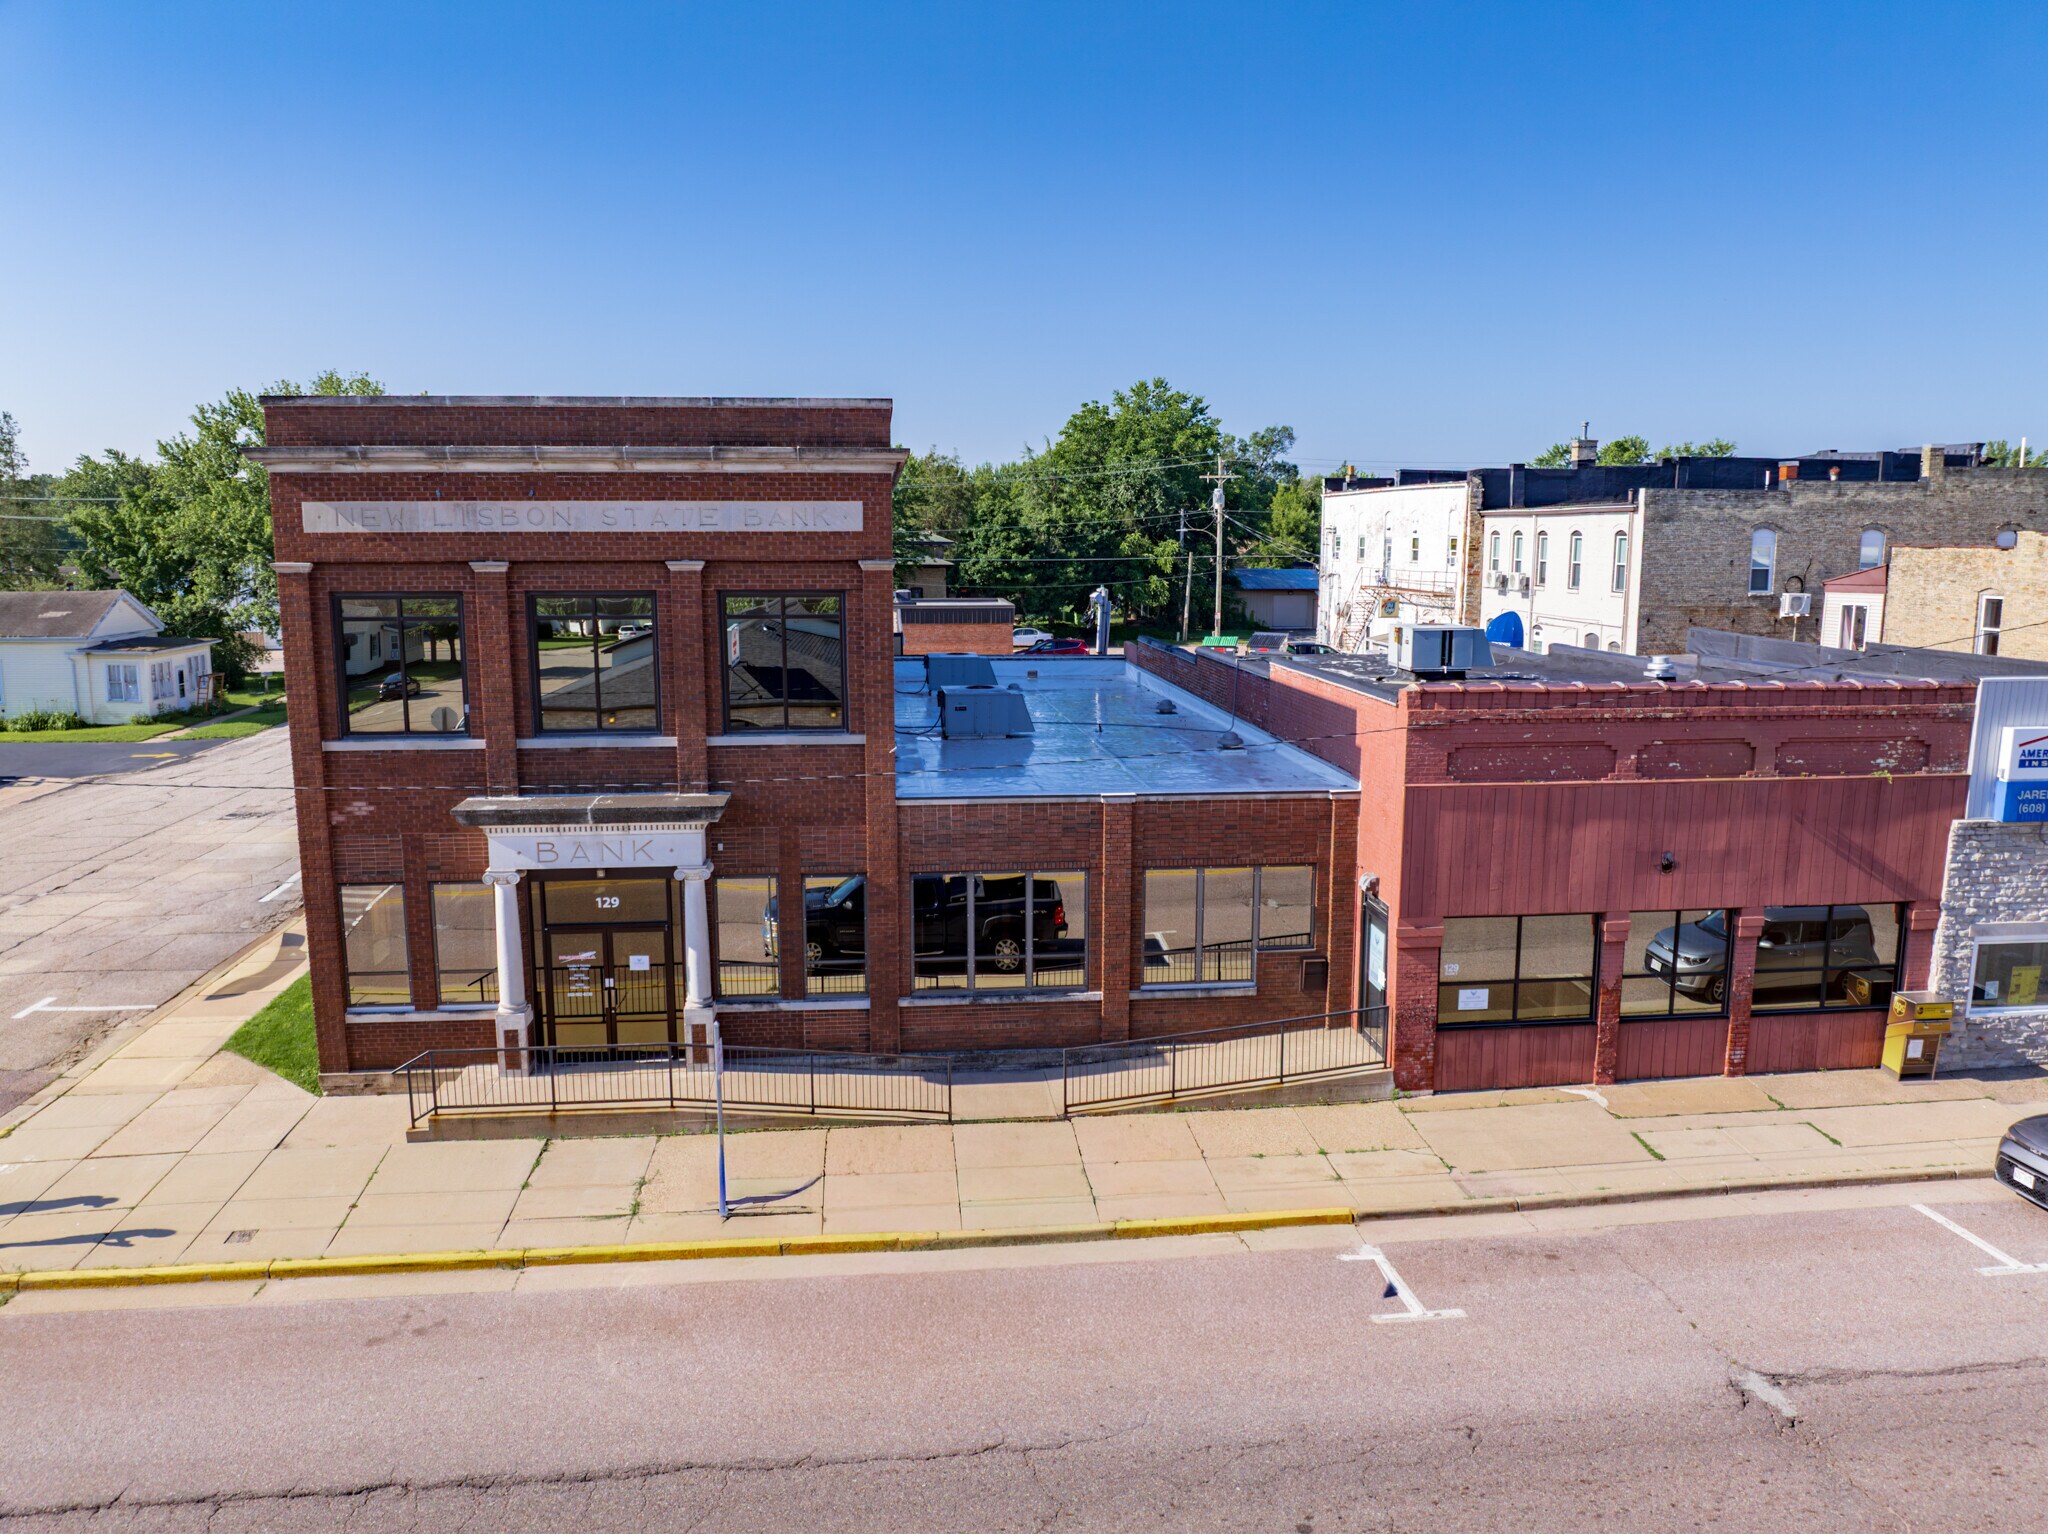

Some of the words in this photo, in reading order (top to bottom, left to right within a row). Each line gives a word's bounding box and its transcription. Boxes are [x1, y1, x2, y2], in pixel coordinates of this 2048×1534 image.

[334, 506, 405, 527] NEW
[432, 506, 572, 527] LISBON
[601, 506, 719, 527] STATE
[743, 506, 832, 527] BANK
[2017, 789, 2048, 800] JARE
[2018, 803, 2046, 815] (608)
[536, 840, 655, 863] BANK
[595, 896, 620, 909] 129
